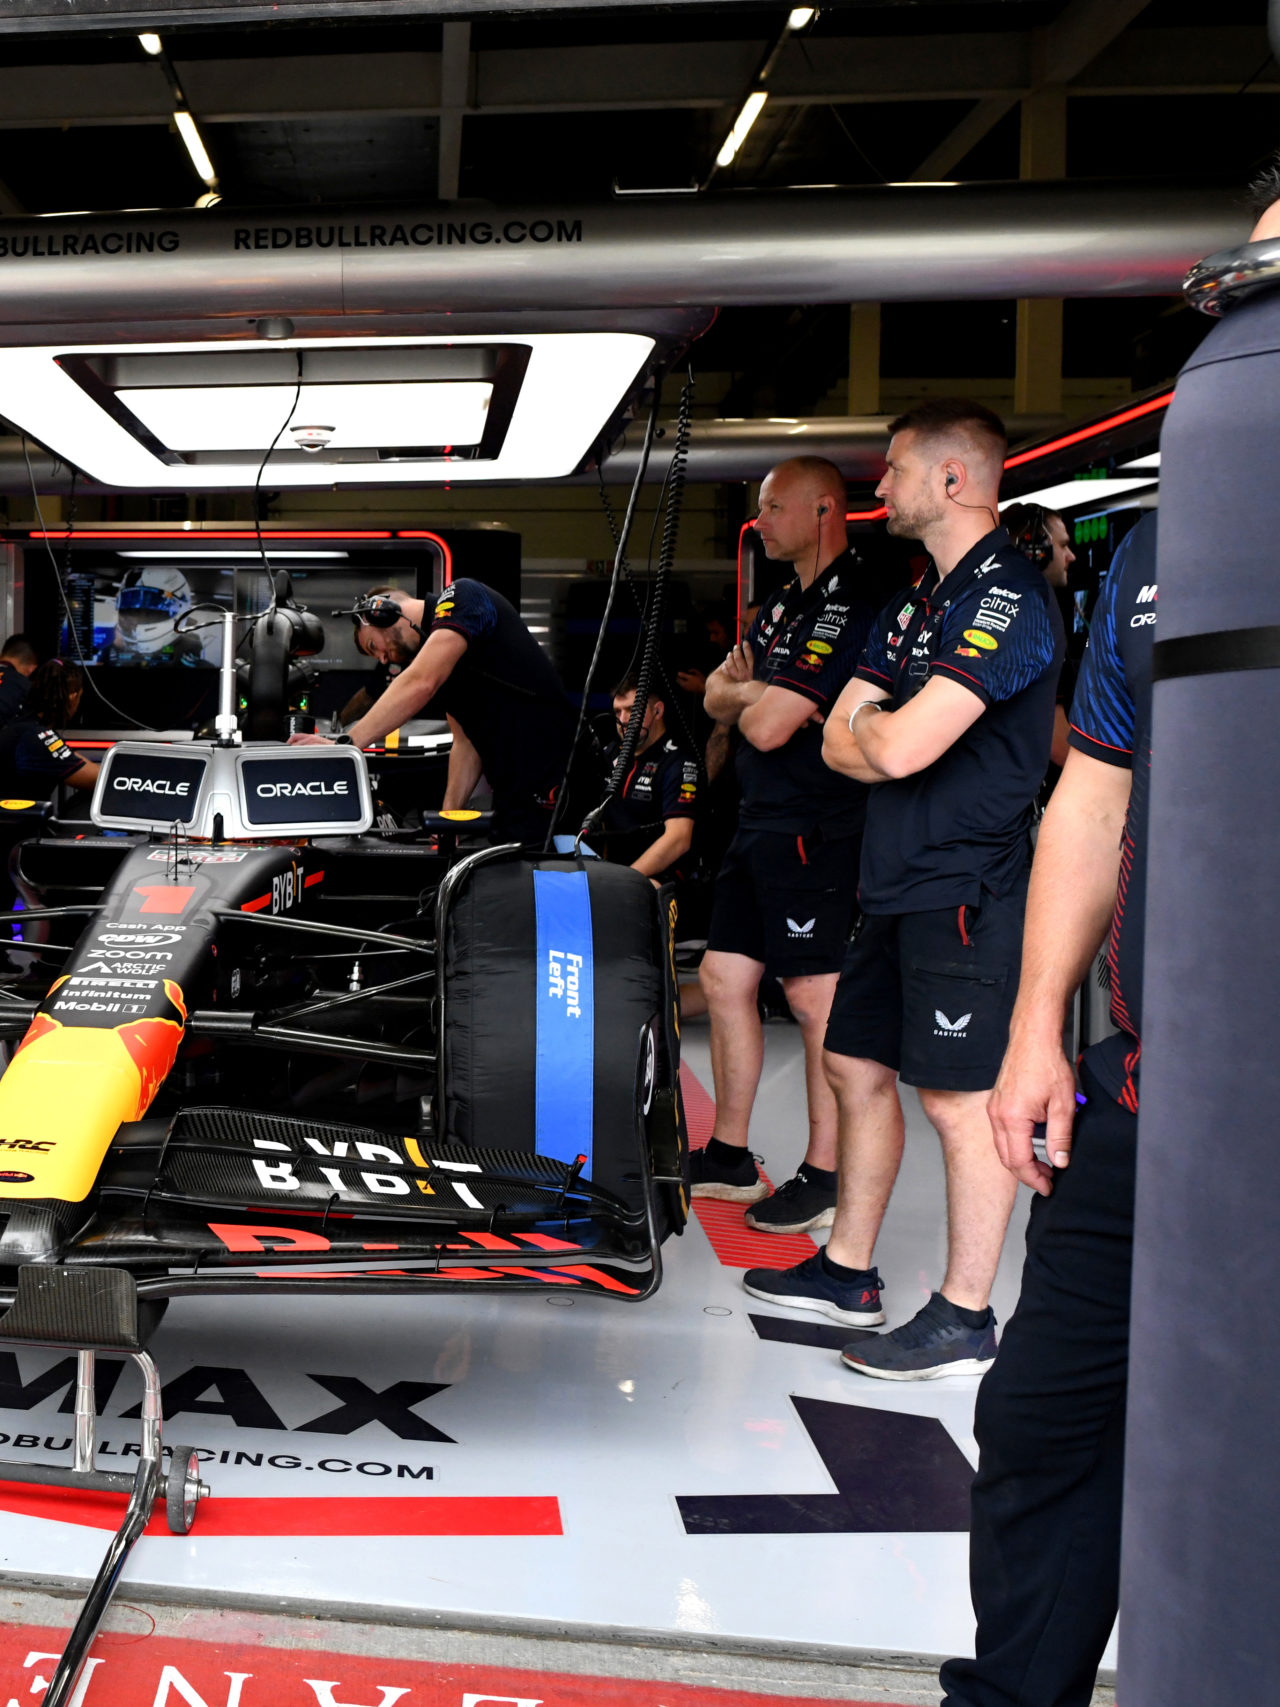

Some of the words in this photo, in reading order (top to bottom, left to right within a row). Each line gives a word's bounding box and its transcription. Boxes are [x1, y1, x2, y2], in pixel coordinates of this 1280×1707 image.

[233, 219, 583, 250] REDBULLRACING.COM
[980, 597, 1020, 617] citrix
[113, 777, 190, 796] ORACLE
[256, 780, 349, 798] ORACLE
[272, 860, 304, 916] BYBIT
[133, 885, 197, 914] 1
[150, 923, 187, 931] App
[111, 962, 167, 971] ARCTIC
[549, 949, 565, 998] Left
[69, 977, 159, 989] PIRELLI
[566, 953, 583, 1018] Front
[53, 1001, 121, 1012] Mobil
